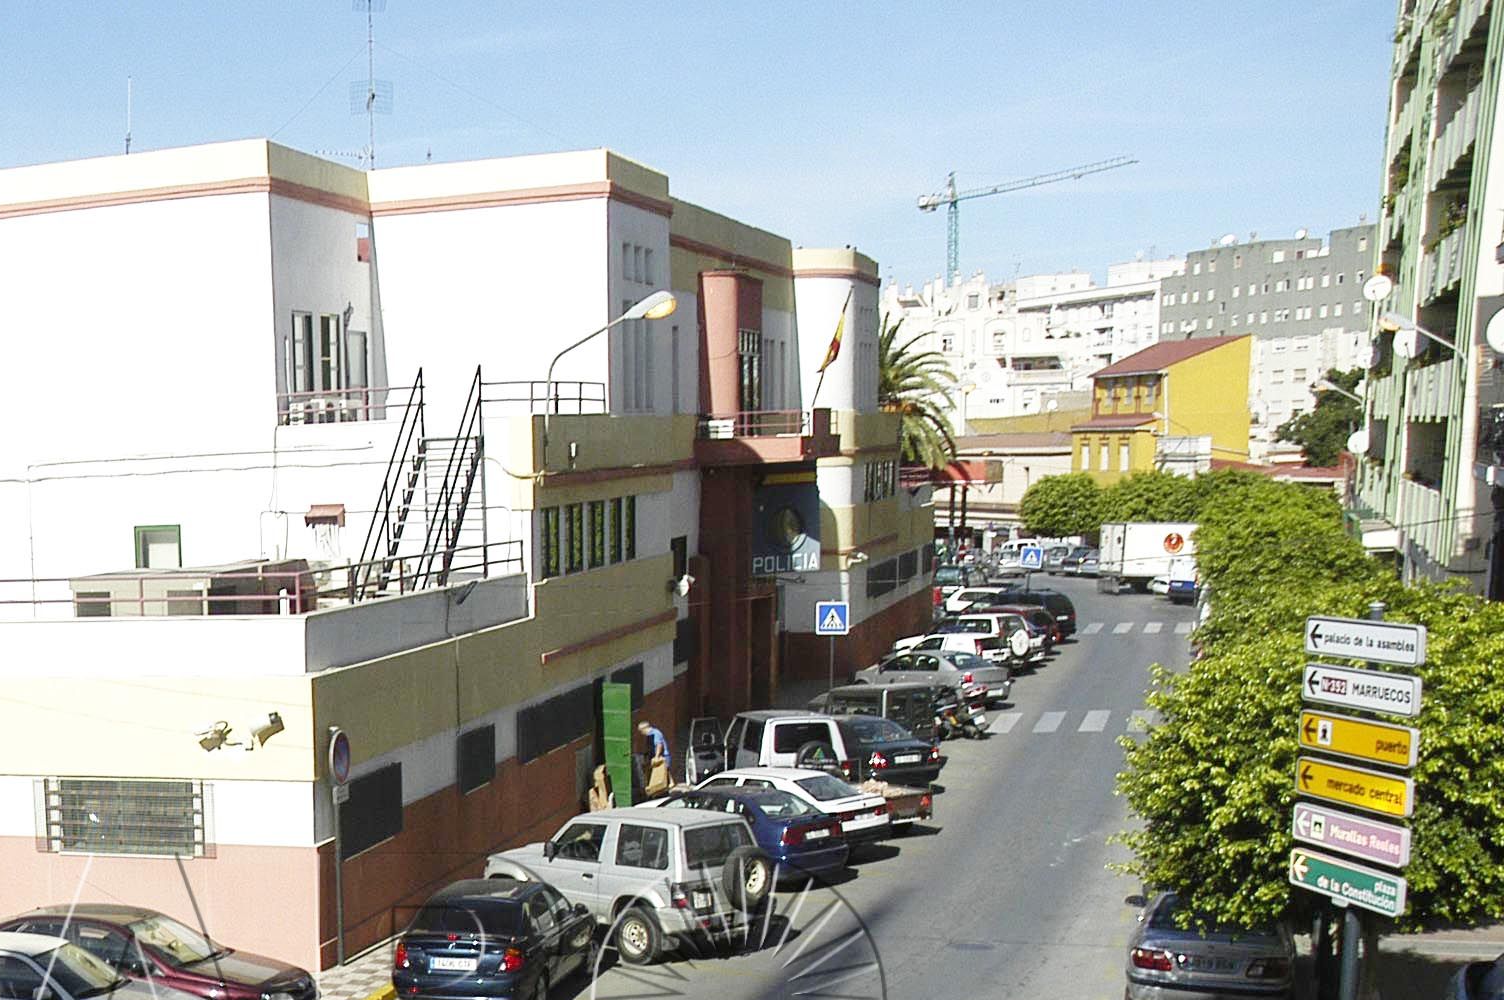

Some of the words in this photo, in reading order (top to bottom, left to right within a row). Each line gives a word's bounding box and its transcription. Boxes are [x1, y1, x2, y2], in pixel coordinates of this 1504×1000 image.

[752, 552, 819, 573] POLICIA
[1324, 633, 1351, 645] palacio
[1353, 636, 1363, 647] de
[1366, 636, 1373, 647] la
[1377, 639, 1414, 652] asamblea
[1351, 683, 1411, 704] MARRUECOS
[1375, 739, 1408, 755] puerto
[1326, 778, 1366, 796] mercado
[1369, 788, 1403, 806] central
[1329, 823, 1368, 847] Murallas
[1369, 835, 1400, 855] Reales
[1317, 875, 1329, 889] de
[1330, 878, 1341, 892] la
[1341, 882, 1395, 911] Constitución
[1374, 881, 1396, 896] plaza
